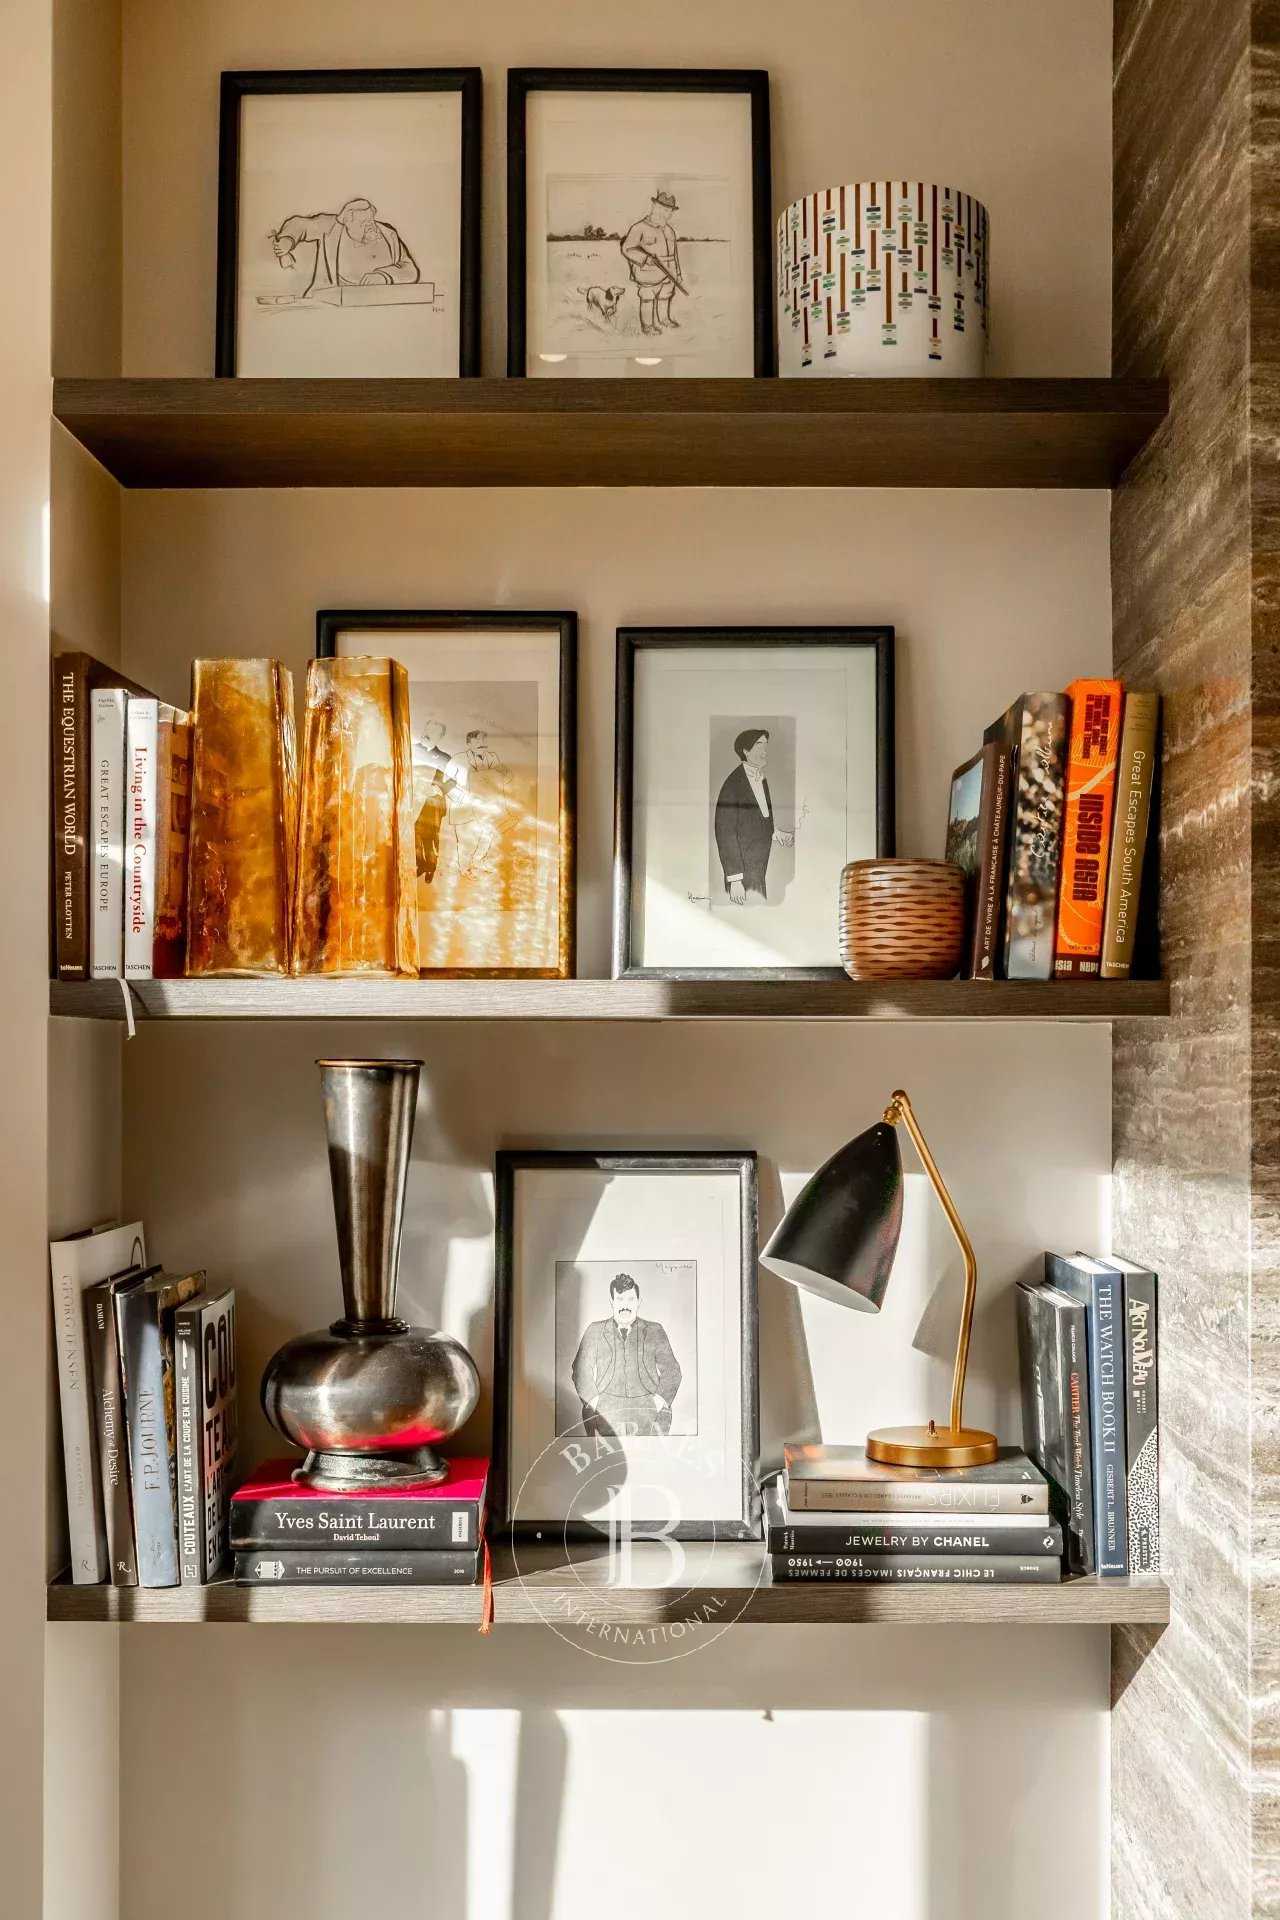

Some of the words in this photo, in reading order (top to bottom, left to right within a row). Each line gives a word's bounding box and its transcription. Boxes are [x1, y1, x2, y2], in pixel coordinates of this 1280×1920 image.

[62, 672, 74, 703] THE
[61, 708, 76, 799] EQUESTRIAN
[100, 759, 110, 800] GREAT
[131, 747, 148, 794] Living
[1131, 750, 1146, 785] Great
[134, 798, 147, 812] in
[1124, 790, 1142, 843] Escapes
[63, 802, 76, 855] WORLD
[100, 807, 109, 858] ESCAPES
[134, 817, 147, 839] the
[1120, 847, 1136, 885] South
[64, 871, 72, 897] PETER
[99, 863, 109, 912] EUROPE
[130, 843, 147, 933] Countryside
[988, 884, 995, 896] LA
[64, 899, 73, 939] CLOTTEN
[1115, 888, 1132, 944] America
[985, 926, 992, 937] DE
[1098, 1284, 1112, 1320] THE
[95, 1303, 105, 1330] DAMIANI
[1100, 1325, 1114, 1385] WATCH
[181, 1376, 190, 1405] CUISINE
[1070, 1372, 1081, 1413] CARTIER
[102, 1389, 116, 1439] Alchemy
[182, 1406, 191, 1417] EN
[1102, 1391, 1116, 1438] BOOK
[182, 1418, 192, 1443] COUPE
[183, 1445, 192, 1456] LA
[1104, 1441, 1115, 1453] II
[107, 1449, 120, 1486] Desire
[183, 1456, 192, 1470] DE
[184, 1470, 193, 1492] L'ART
[1074, 1468, 1083, 1500] Timeless
[1106, 1464, 1115, 1499] GISBERT
[1073, 1501, 1084, 1520] Style
[1107, 1501, 1115, 1509] L.
[183, 1495, 196, 1555] COUTEAUX
[275, 1512, 314, 1529] Yves
[318, 1512, 364, 1529] Saint
[367, 1512, 436, 1529] Laurent
[1107, 1512, 1116, 1552] BRUNNER
[333, 1533, 354, 1541] David
[845, 1536, 908, 1547] JEWELRY
[912, 1536, 929, 1547] BY
[933, 1536, 990, 1547] CHANEL
[296, 1567, 312, 1575] THE
[313, 1567, 347, 1575] PURSUIT
[348, 1567, 361, 1575] OF
[362, 1567, 413, 1575] EXCELLENCE
[788, 1558, 813, 1567] 1950
[788, 1569, 831, 1577] FEMMES
[835, 1569, 848, 1577] DE
[836, 1558, 863, 1567] 1900
[851, 1569, 893, 1577] IMAGES
[897, 1566, 950, 1578] FRANÇAIS
[953, 1569, 981, 1578] CHIC
[984, 1569, 995, 1578] LE
